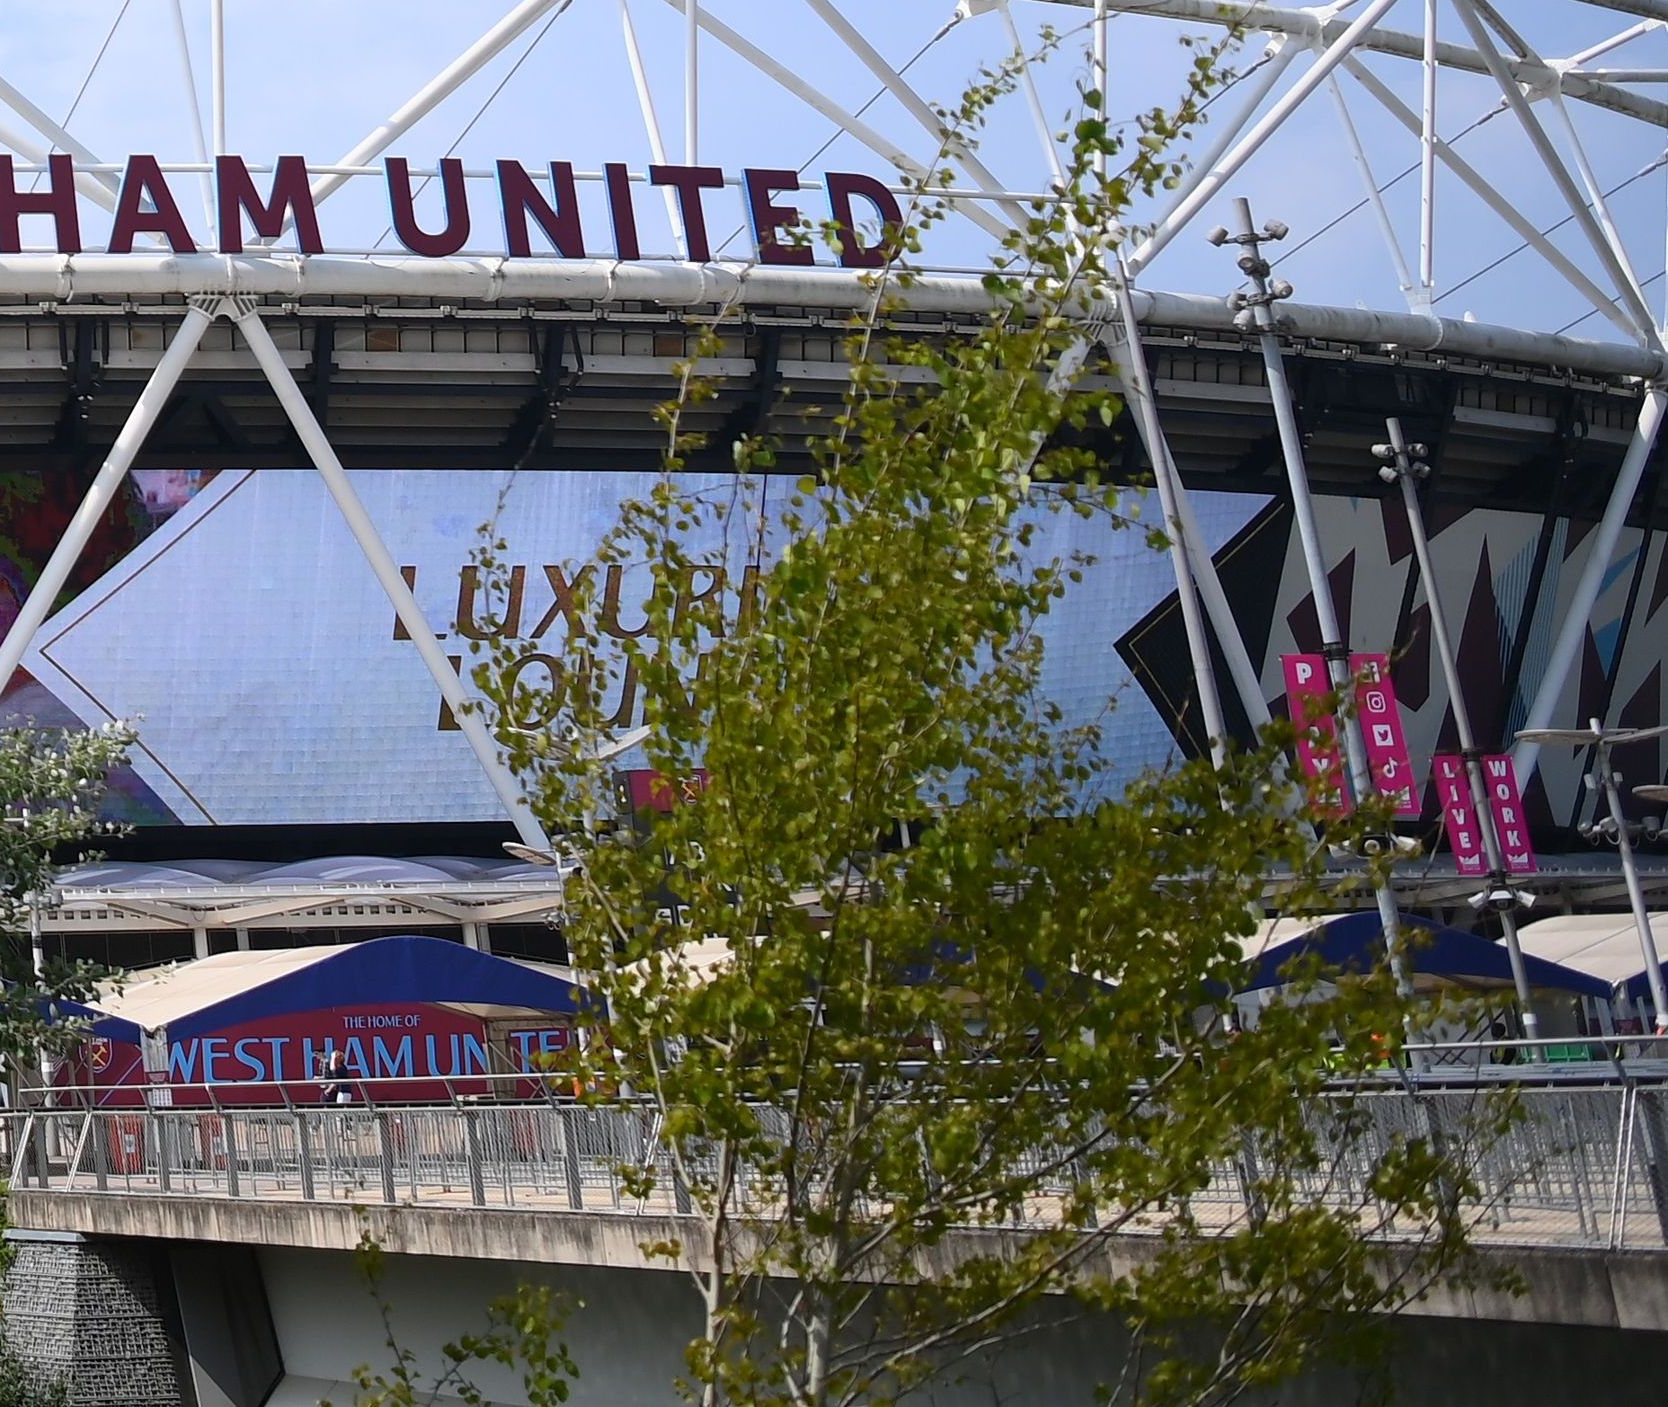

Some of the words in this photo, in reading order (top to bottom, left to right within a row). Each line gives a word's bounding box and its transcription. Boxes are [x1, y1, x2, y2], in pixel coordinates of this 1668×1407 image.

[384, 156, 903, 268] UNITED
[1443, 762, 1471, 848] LIVE
[1488, 760, 1521, 846] WORK
[169, 1037, 291, 1084] WEST
[302, 1034, 414, 1081] HAM
[424, 1030, 574, 1080] UNTE
[343, 1015, 366, 1029] THE
[368, 1015, 403, 1028] HOME
[404, 1014, 421, 1027] OF
